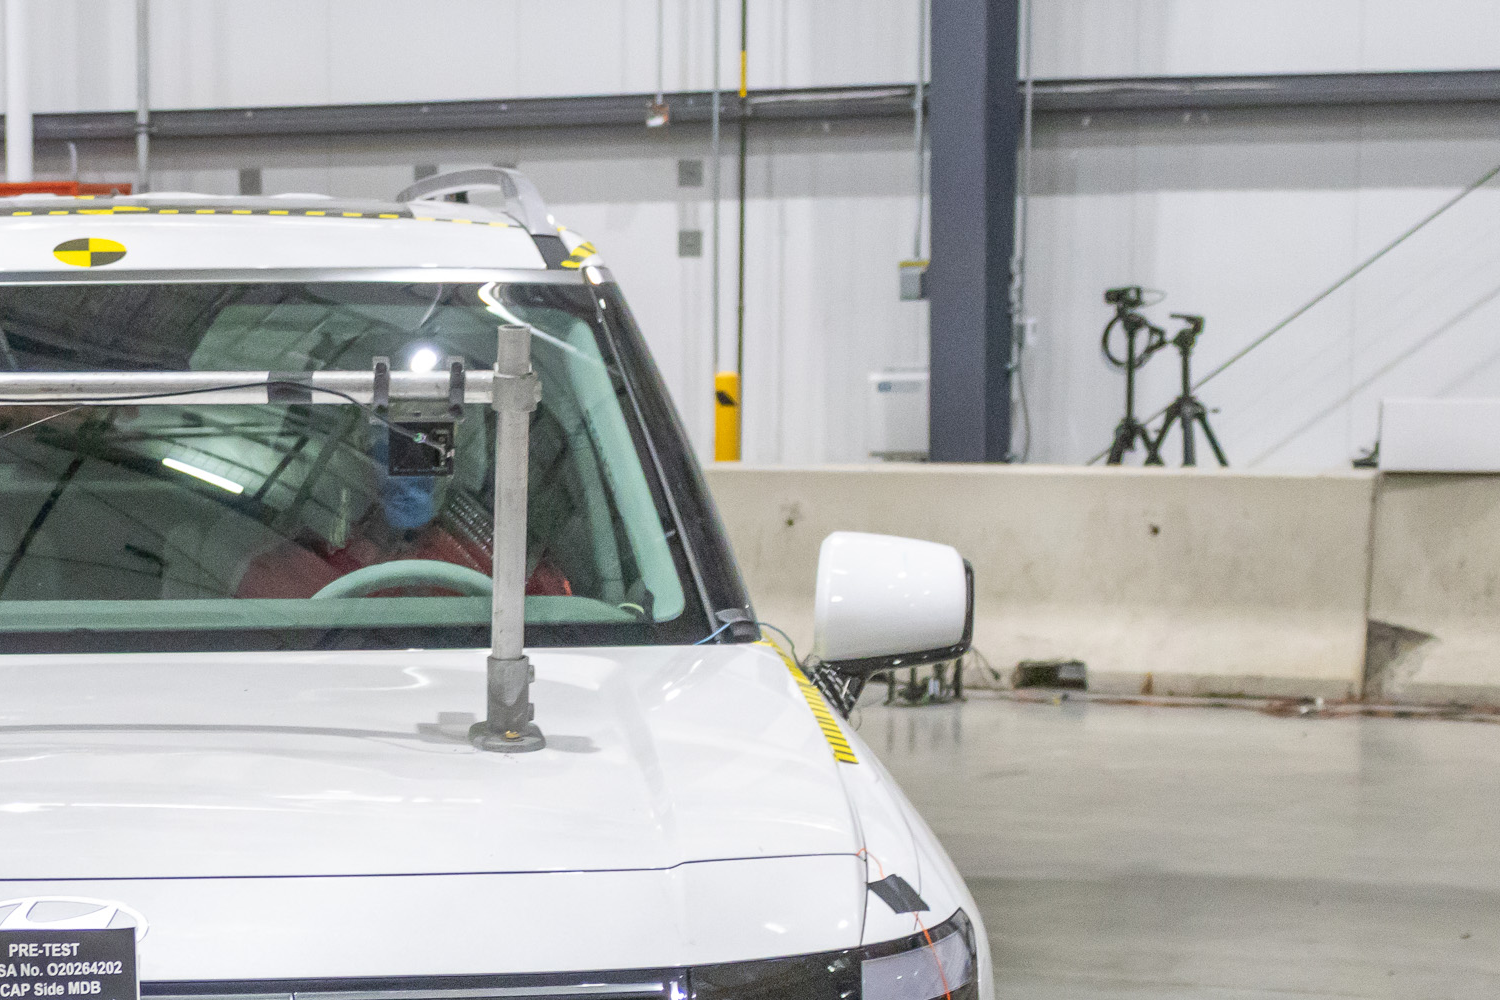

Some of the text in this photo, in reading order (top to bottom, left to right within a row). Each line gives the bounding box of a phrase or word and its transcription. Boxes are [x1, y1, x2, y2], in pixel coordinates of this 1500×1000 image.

[8, 943, 80, 957] PRE-TEST
[20, 963, 43, 977] No.
[34, 983, 64, 996] Side
[68, 981, 101, 995] MDB
